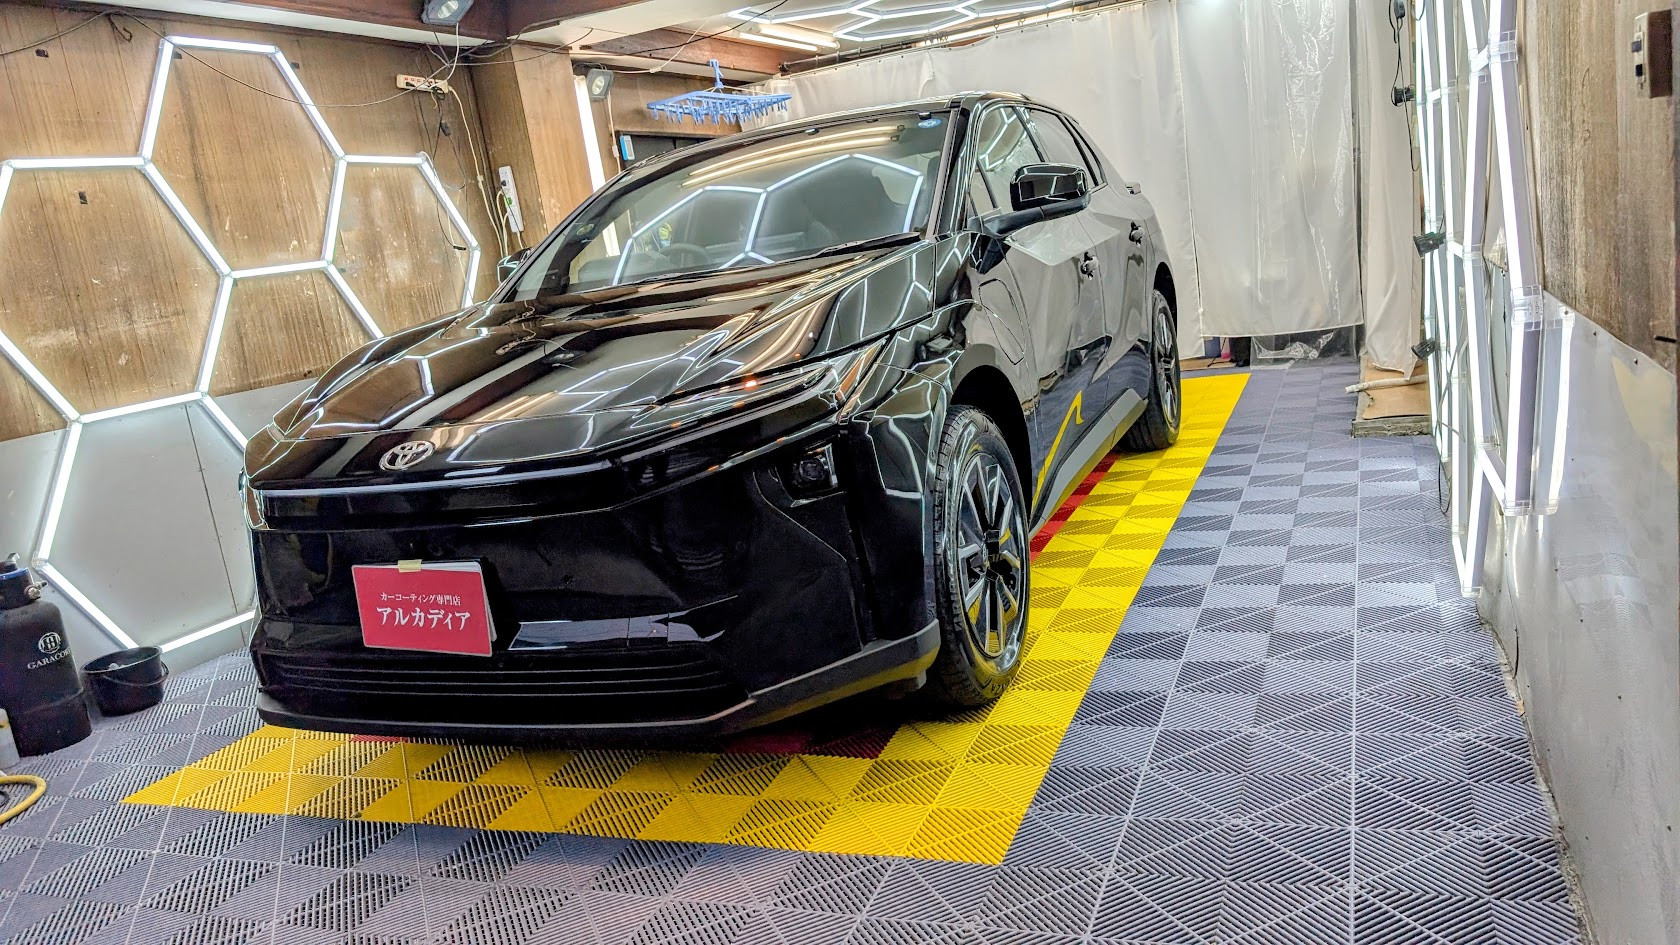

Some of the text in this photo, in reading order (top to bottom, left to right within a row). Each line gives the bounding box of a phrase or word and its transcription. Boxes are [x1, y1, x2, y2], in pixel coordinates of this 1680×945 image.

[380, 592, 461, 606] カーコーティング専門店
[376, 606, 471, 631] アルカディア
